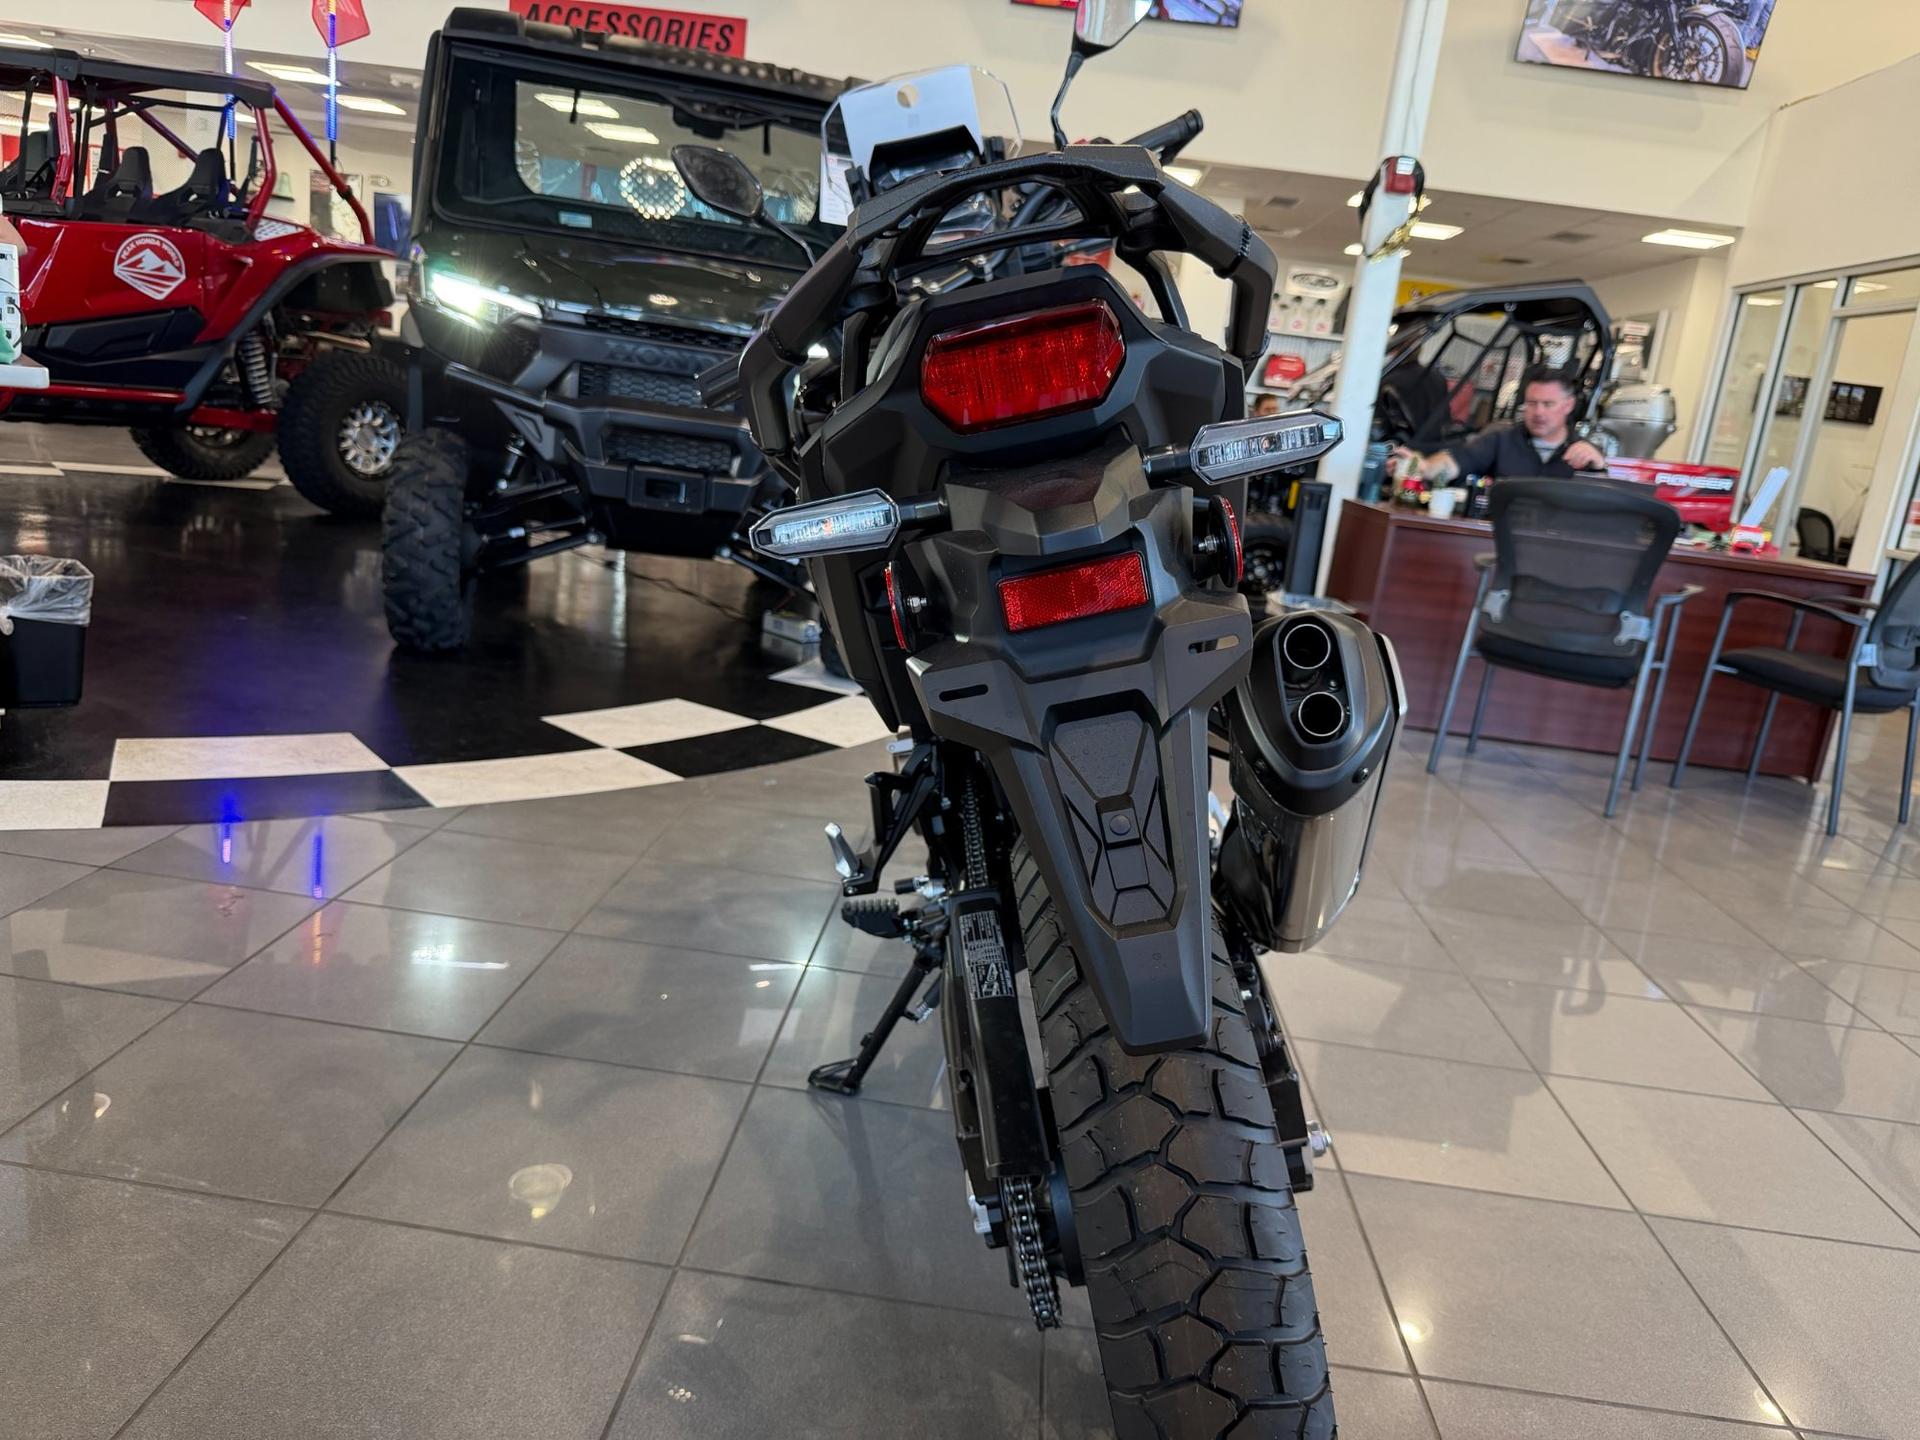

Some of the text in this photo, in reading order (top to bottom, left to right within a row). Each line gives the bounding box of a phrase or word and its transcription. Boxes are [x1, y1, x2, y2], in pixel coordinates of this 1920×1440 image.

[525, 3, 735, 53] ACCESSORIES
[135, 237, 161, 247] HONDA
[161, 242, 181, 267] WORLD
[605, 340, 721, 374] HOND
[1655, 472, 1733, 491] PIONEER
